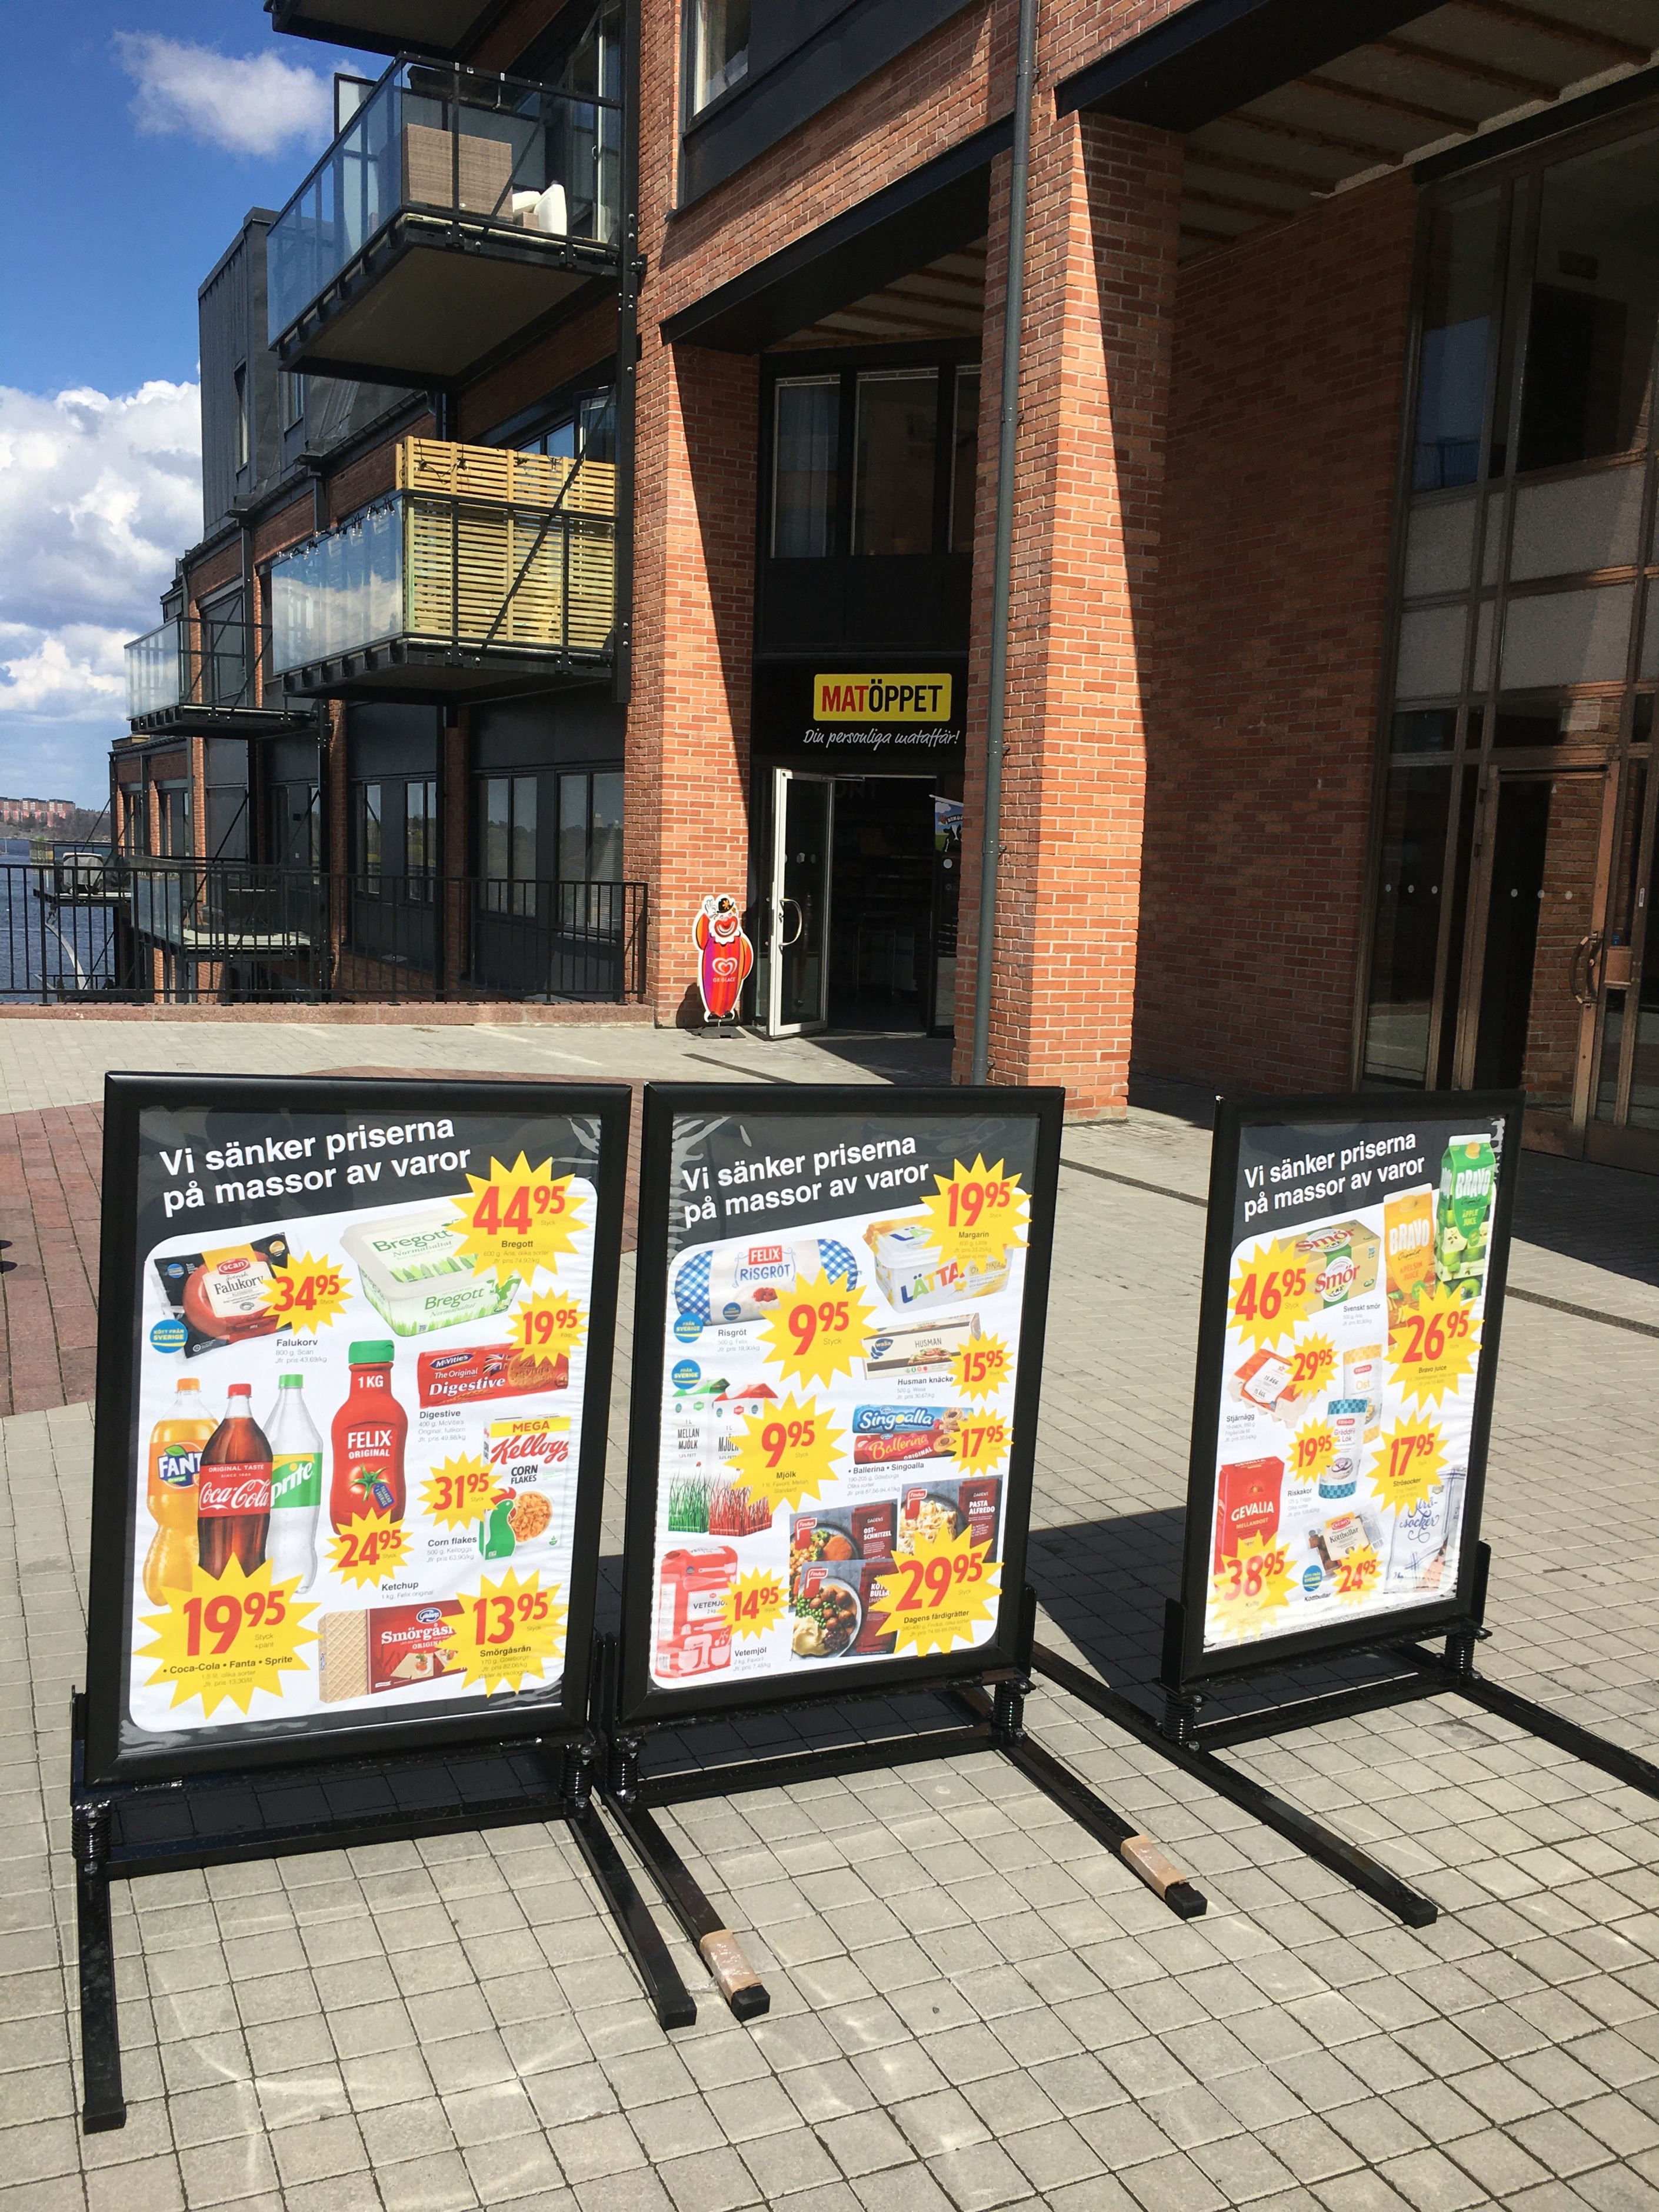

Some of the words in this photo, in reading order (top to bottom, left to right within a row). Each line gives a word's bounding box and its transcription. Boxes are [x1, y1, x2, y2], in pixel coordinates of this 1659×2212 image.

[822, 678, 942, 712] MATÖPPET
[803, 728, 824, 744] Din
[825, 728, 891, 751] personliga
[894, 728, 960, 747] mataffär!
[159, 1148, 195, 1176] Vi
[205, 1137, 316, 1171] sänker
[326, 1119, 455, 1161] priserna
[682, 1167, 709, 1192] Vi
[718, 1155, 805, 1187] sänker
[814, 1137, 916, 1176] priserna
[1244, 1166, 1264, 1188] Vi
[1270, 1154, 1335, 1183] sänker
[1341, 1134, 1416, 1171] priserna
[164, 1180, 205, 1218] på
[215, 1167, 337, 1204] massor
[347, 1161, 382, 1185] av
[391, 1148, 471, 1178] varor
[1245, 1191, 1268, 1222] på
[1274, 1177, 1345, 1210] massor
[1351, 1170, 1372, 1190] av
[1377, 1156, 1425, 1182] varor
[1456, 1170, 1491, 1199] BRAVO
[684, 1195, 717, 1228] på
[725, 1182, 822, 1216] massor
[830, 1176, 858, 1197] av
[865, 1163, 929, 1191] varor
[1464, 1217, 1476, 1226] JUICE
[372, 1230, 454, 1252] Bregott
[958, 1231, 989, 1240] Margarin
[1295, 1228, 1355, 1252] Smör
[1390, 1218, 1429, 1255] BRAVO
[501, 1240, 533, 1250] Bregott
[751, 1248, 781, 1262] FELIX
[223, 1261, 244, 1270] scan
[901, 1262, 965, 1304] LÄTTA
[1314, 1264, 1360, 1294] Smör
[424, 1287, 484, 1311] Bregott
[718, 1329, 747, 1338] Risgröt
[276, 1339, 318, 1347] Falukorv
[915, 1337, 941, 1348] HUSMAN
[449, 1367, 478, 1379] Original
[367, 1375, 384, 1387] KG
[897, 1377, 927, 1385] Husman
[929, 1375, 953, 1384] knäcke
[1355, 1380, 1370, 1390] Ost
[429, 1377, 506, 1396] Digestive
[419, 1410, 461, 1420] Digestive
[860, 1408, 932, 1430] Singoalla
[1227, 1414, 1255, 1423] Stjärnägg
[512, 1421, 550, 1433] MEGA
[348, 1430, 391, 1449] FELIX
[677, 1428, 699, 1439] MELLAN
[678, 1440, 698, 1450] MJÖLK
[869, 1434, 927, 1460] Ballerina
[349, 1449, 390, 1460] ORIGINAL
[904, 1447, 933, 1460] ORIGINAL
[511, 1464, 538, 1477] CORN
[854, 1466, 884, 1474] Ballerina
[891, 1463, 924, 1473] Singoalla
[511, 1474, 537, 1484] FLAKES
[776, 1471, 796, 1480] Mjölk
[270, 1462, 313, 1507] prite
[199, 1479, 271, 1510] Coca-Cola
[1288, 1488, 1312, 1497] Riskakor
[969, 1506, 995, 1515] ALFREDO
[1231, 1501, 1274, 1521] GEVALIA
[451, 1536, 477, 1544] flakes
[864, 1531, 892, 1540] SCHNITZEL
[382, 1581, 419, 1592] Ketchup
[904, 1615, 930, 1624] Dagens
[931, 1610, 970, 1621] färdigrätter
[480, 1645, 531, 1657] Smörgåsrån
[735, 1647, 767, 1657] Vetemjöl
[169, 1663, 220, 1674] Coca-Cola
[229, 1660, 256, 1669] Fanta
[265, 1656, 292, 1667] Sprite
